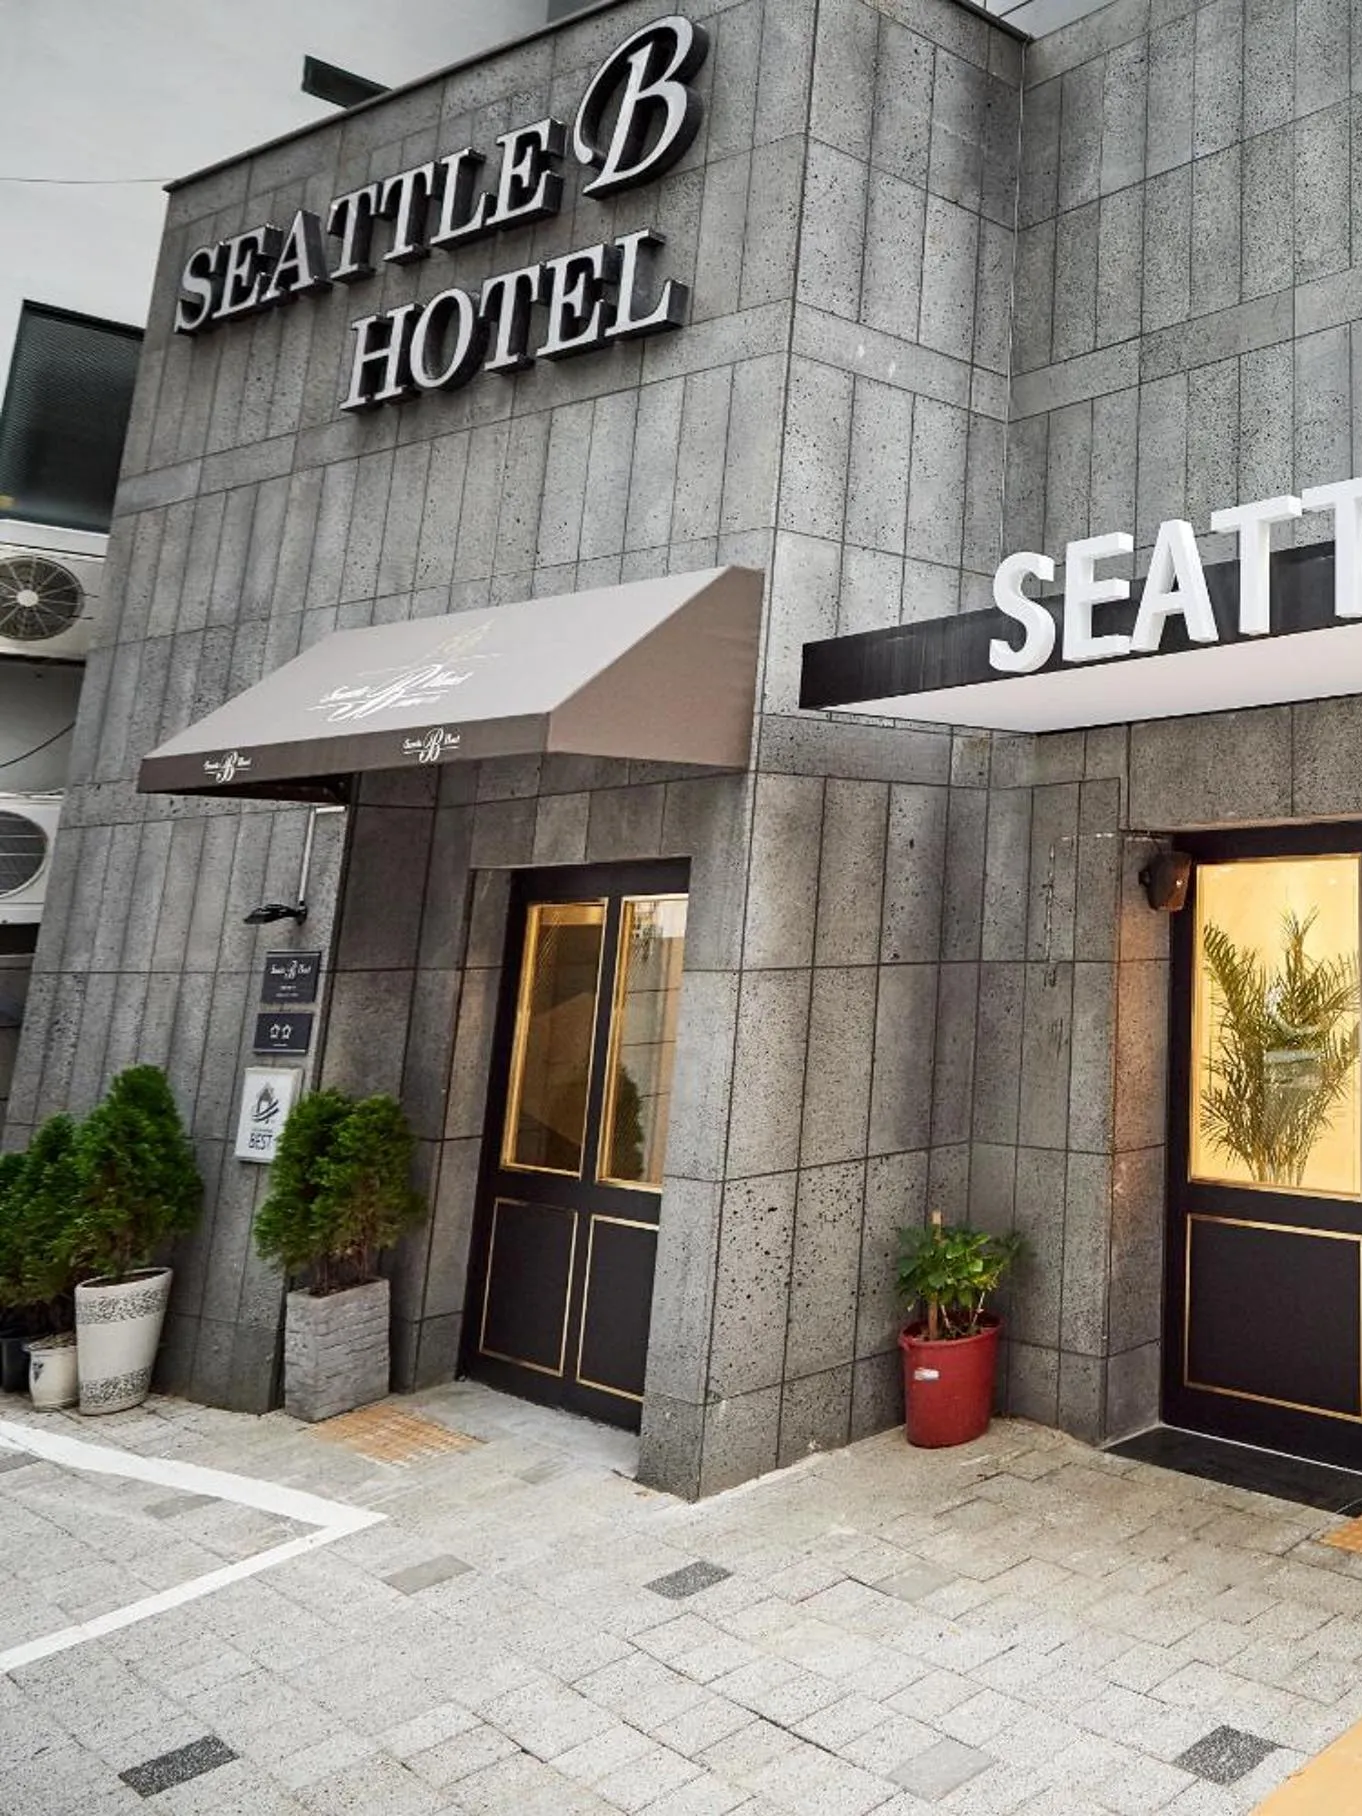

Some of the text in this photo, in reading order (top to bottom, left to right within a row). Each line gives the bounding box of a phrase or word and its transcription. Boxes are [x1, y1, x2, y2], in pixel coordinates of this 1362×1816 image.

[174, 15, 709, 335] SEATTLE B
[339, 227, 688, 413] HOTEL
[249, 1132, 273, 1151] BEST
